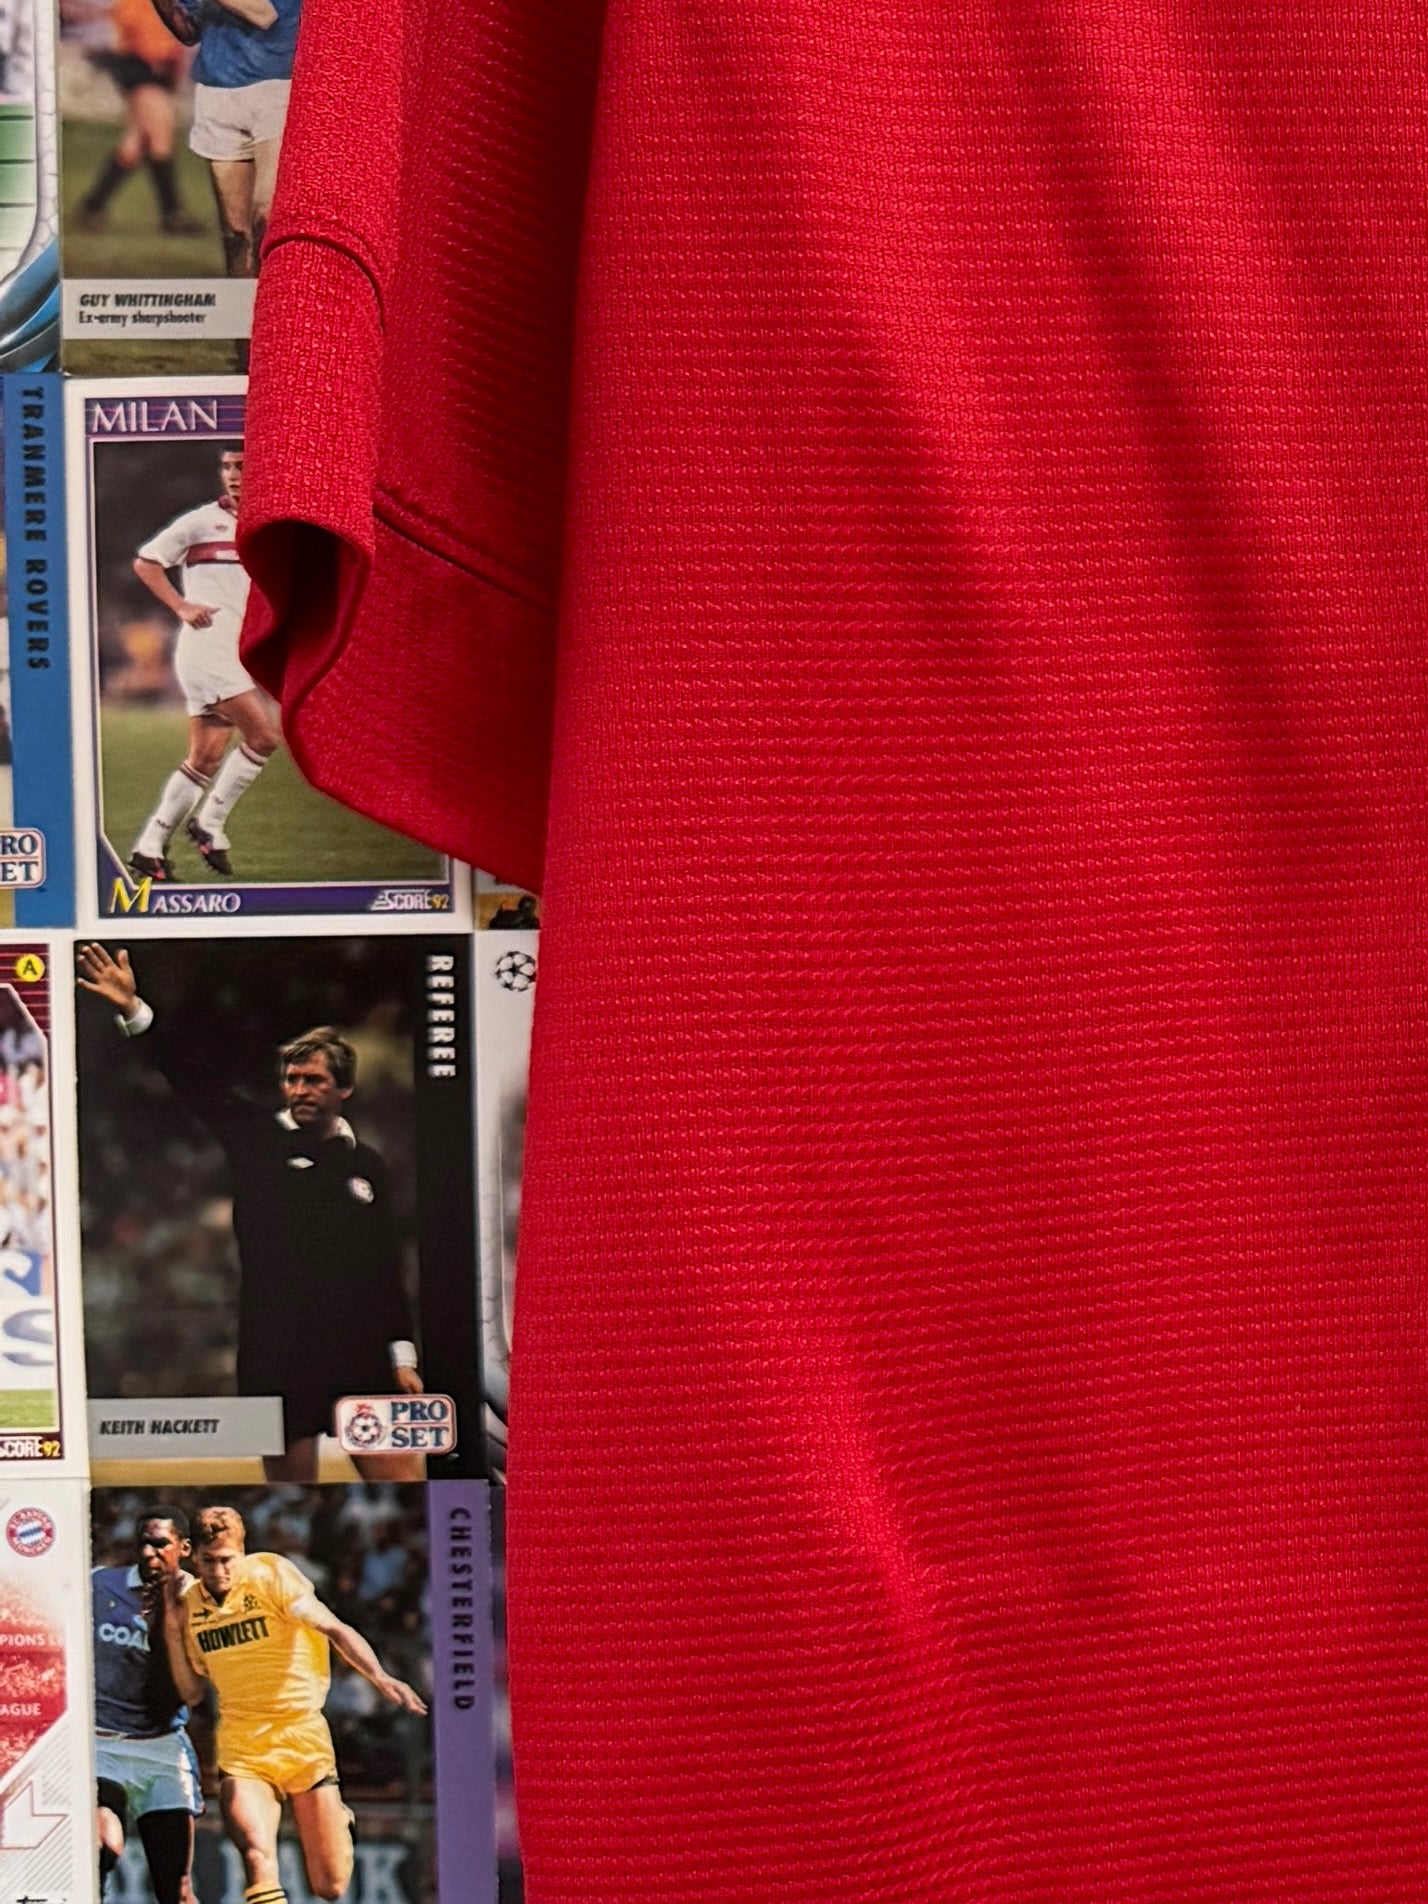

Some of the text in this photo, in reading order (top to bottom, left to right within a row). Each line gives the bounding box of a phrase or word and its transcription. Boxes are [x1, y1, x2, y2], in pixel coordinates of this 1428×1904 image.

[80, 293, 216, 307] GUY WHITTINGHAM
[92, 399, 218, 432] MILAN
[22, 386, 49, 671] TRANMERE ROVERS
[109, 877, 241, 914] MASSARO
[427, 954, 456, 1079] REFEREE
[100, 1419, 219, 1434] KEITH HACKETT
[448, 1506, 475, 1711] CHESTERFIELD
[197, 1616, 270, 1653] HOWLETT
